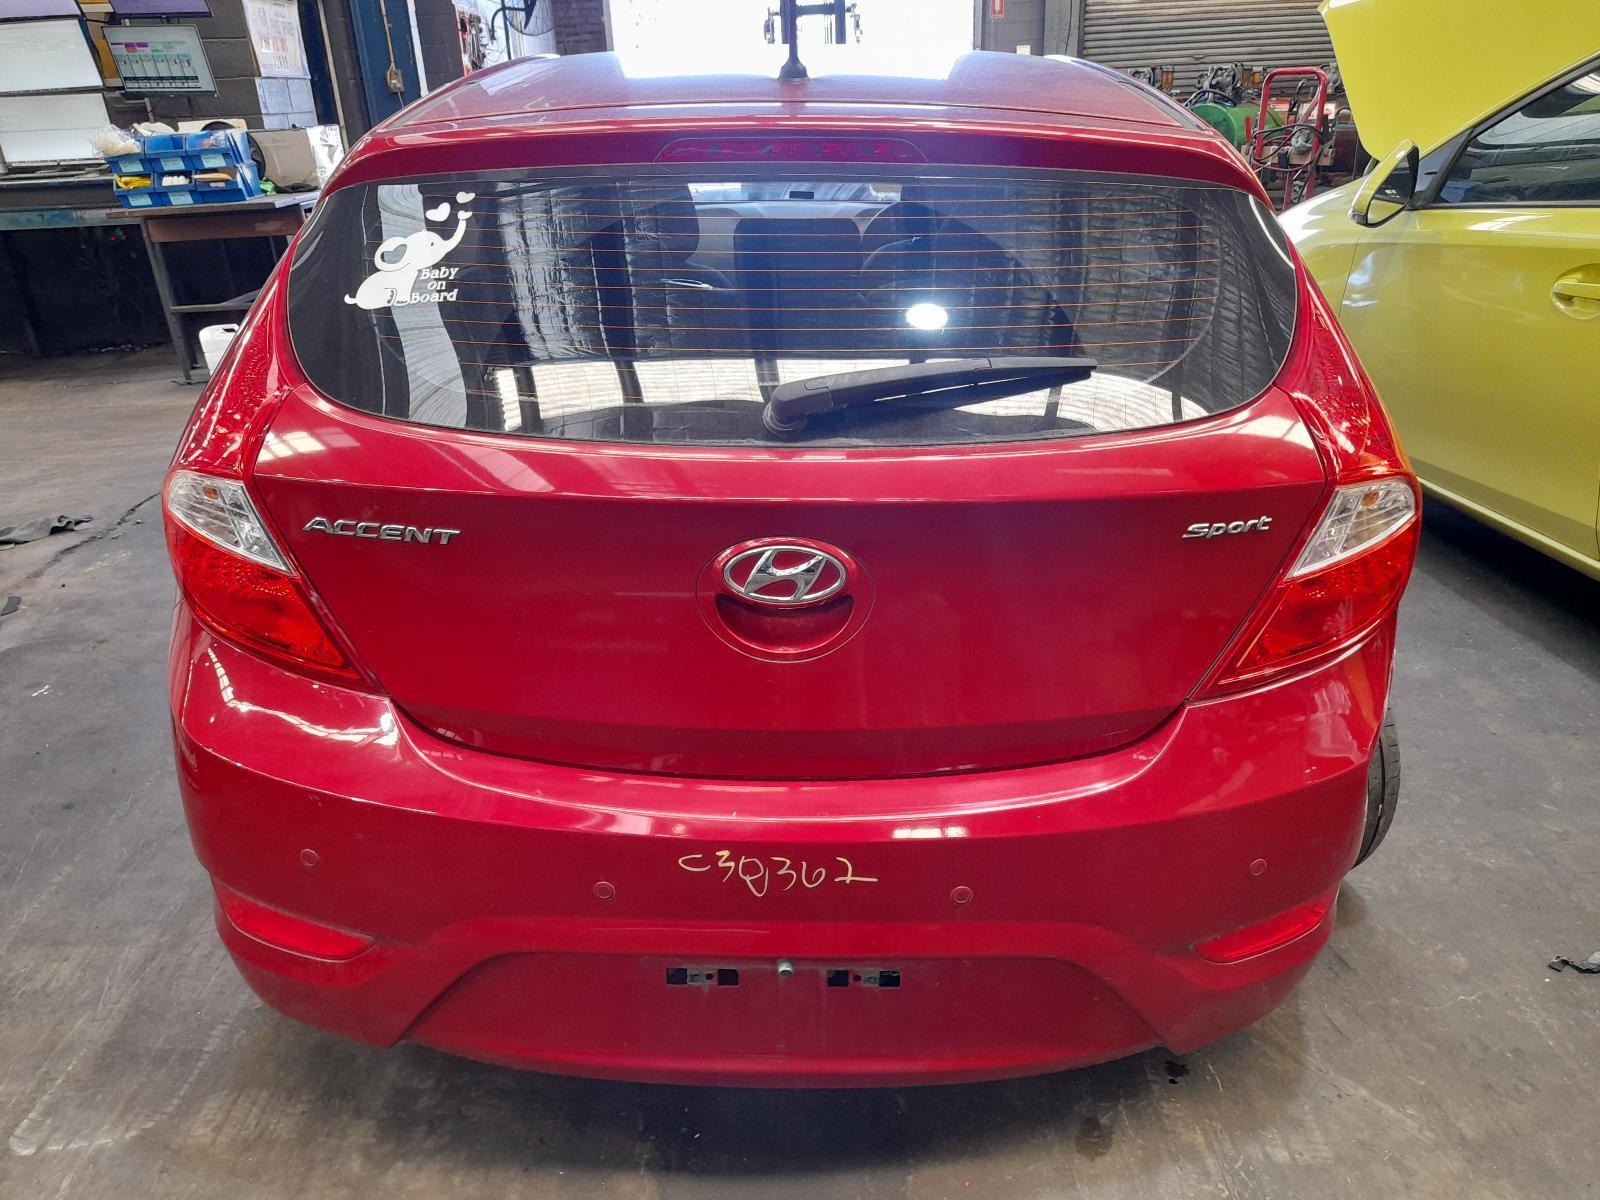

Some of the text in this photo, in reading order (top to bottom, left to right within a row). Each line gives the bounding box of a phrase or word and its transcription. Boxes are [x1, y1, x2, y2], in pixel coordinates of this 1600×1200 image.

[420, 266, 459, 280] Baby
[427, 281, 446, 290] on
[411, 290, 458, 304] Board
[302, 516, 463, 545] ACCENT
[1182, 515, 1273, 539] Sport
